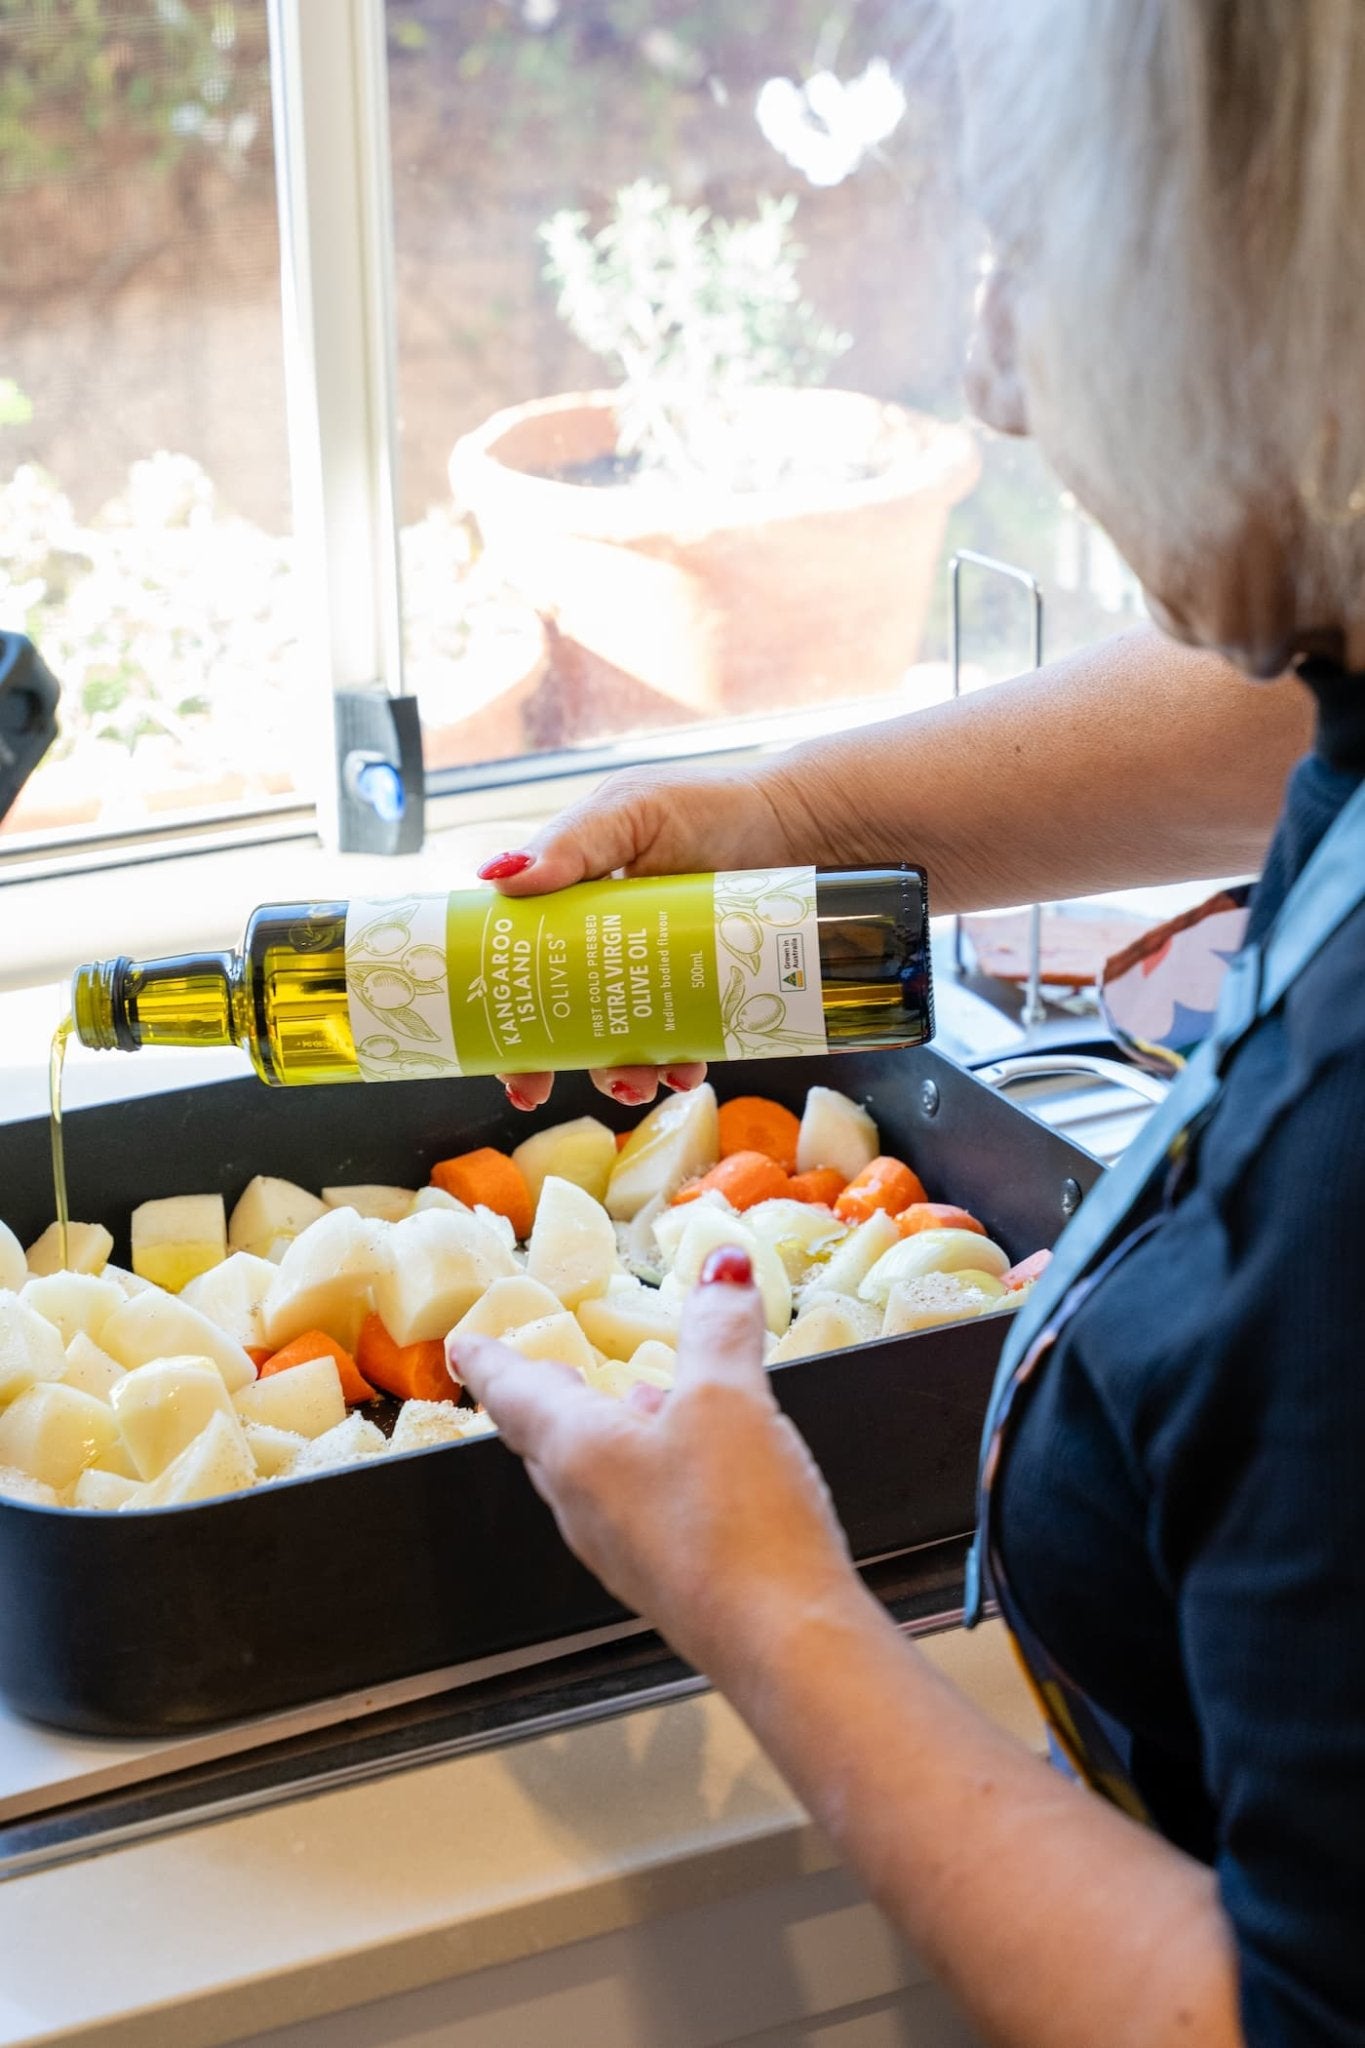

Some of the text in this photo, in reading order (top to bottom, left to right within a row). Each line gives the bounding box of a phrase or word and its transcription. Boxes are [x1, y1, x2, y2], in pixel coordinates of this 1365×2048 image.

[492, 918, 522, 1045] KANGAROO
[513, 940, 537, 1022] ISLAND
[586, 914, 604, 1038] FIRST COLD PRESSED
[602, 914, 629, 1035] EXTRA VIRGIN
[627, 928, 653, 1018] OLIVE OIL
[657, 910, 676, 1032] Medium bodied flavour
[690, 950, 705, 988] 500mL
[783, 939, 790, 947] in
[791, 937, 799, 969] Australia
